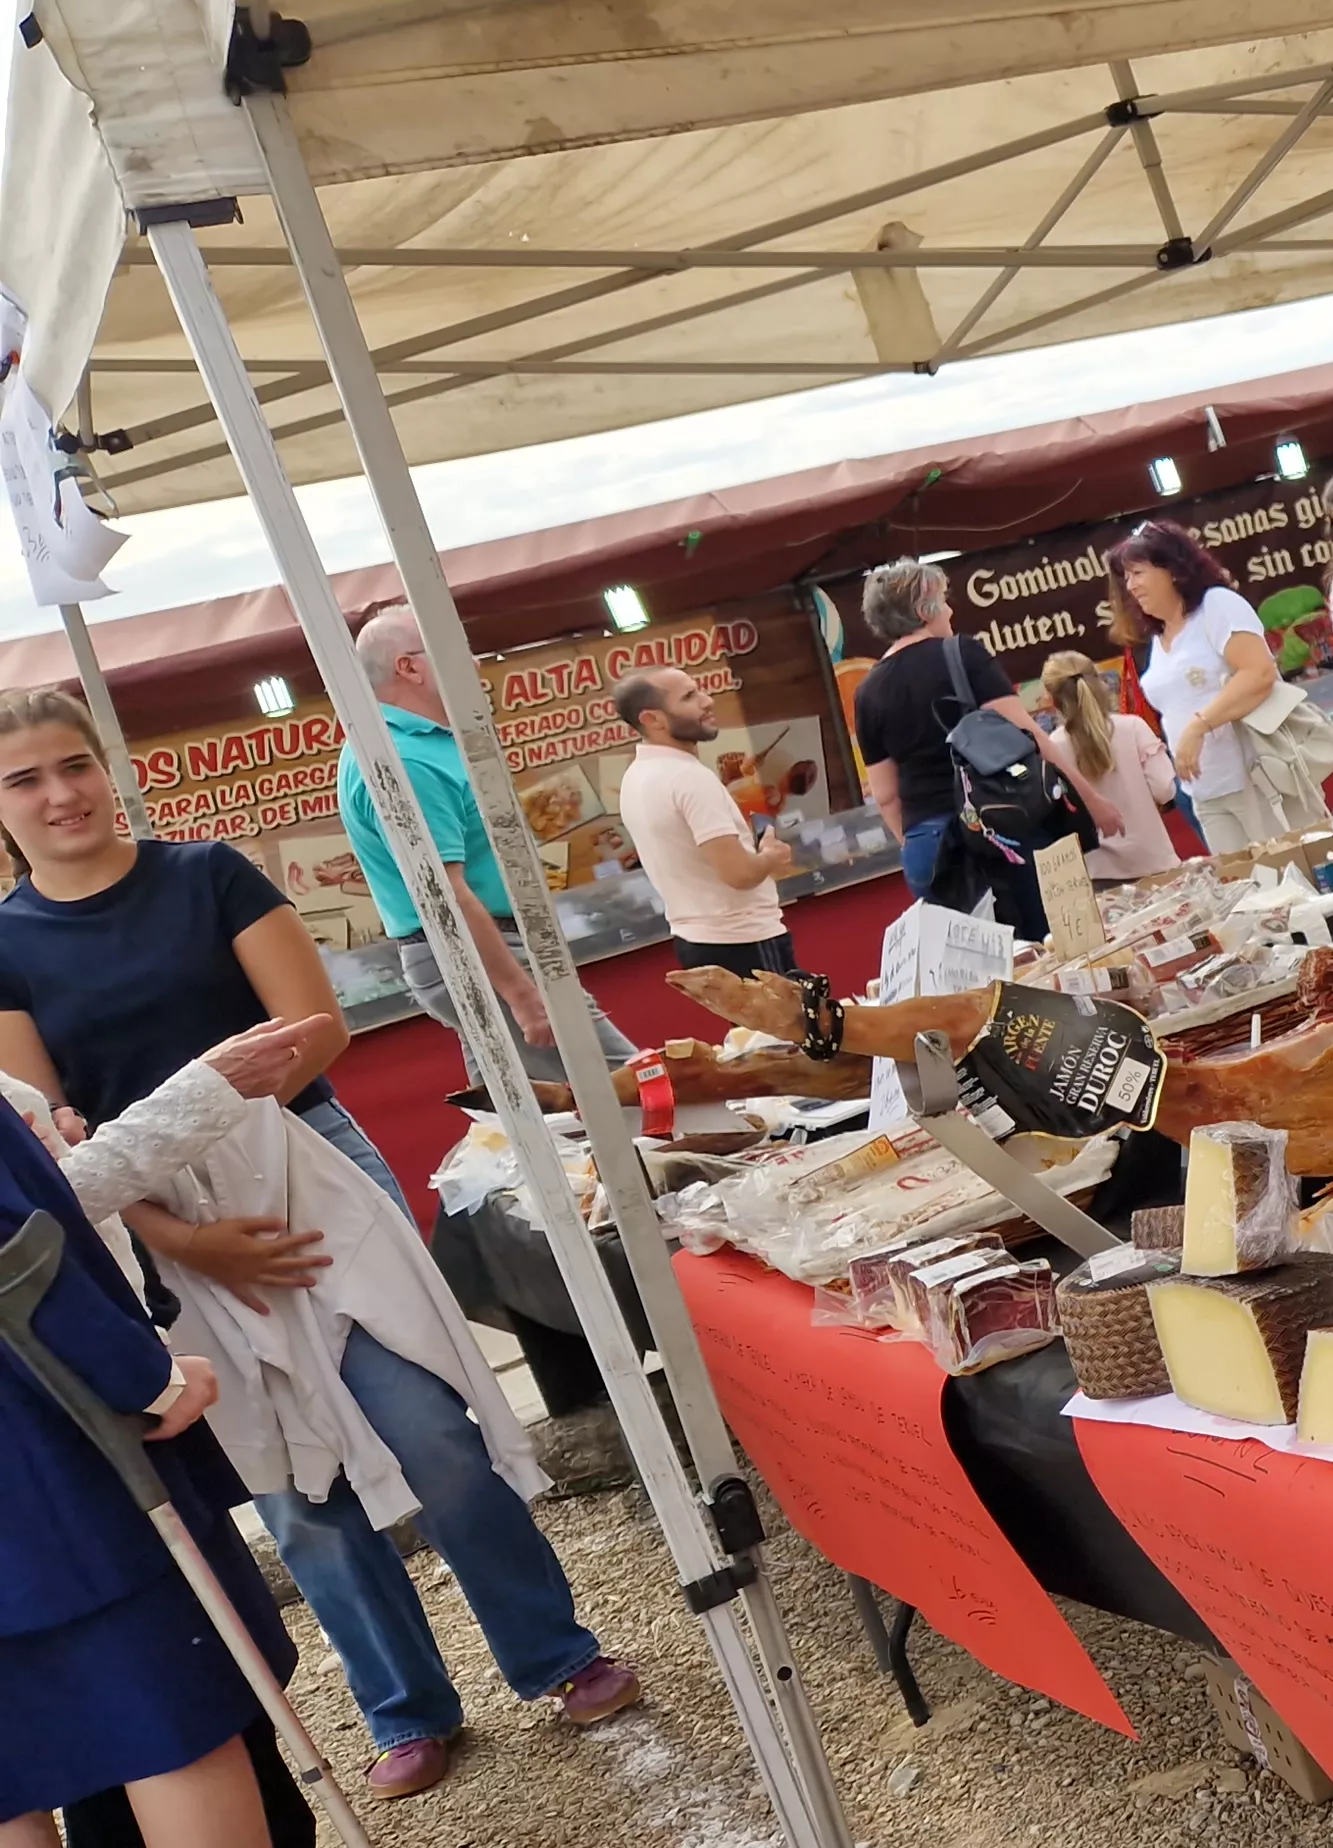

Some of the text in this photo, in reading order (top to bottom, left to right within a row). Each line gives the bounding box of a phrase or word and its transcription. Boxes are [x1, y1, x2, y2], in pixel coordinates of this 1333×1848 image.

[1247, 545, 1295, 583] sin
[504, 657, 600, 708] ALTA
[607, 620, 758, 678] CALIDAD
[219, 781, 252, 808] LA
[261, 802, 296, 824] DE
[1061, 905, 1073, 941] 4
[1049, 1044, 1083, 1102] JAMÓN
[1065, 1026, 1108, 1106] GRAN RESERVA
[1077, 1031, 1128, 1114] DUROC
[1118, 1070, 1142, 1102] 50%
